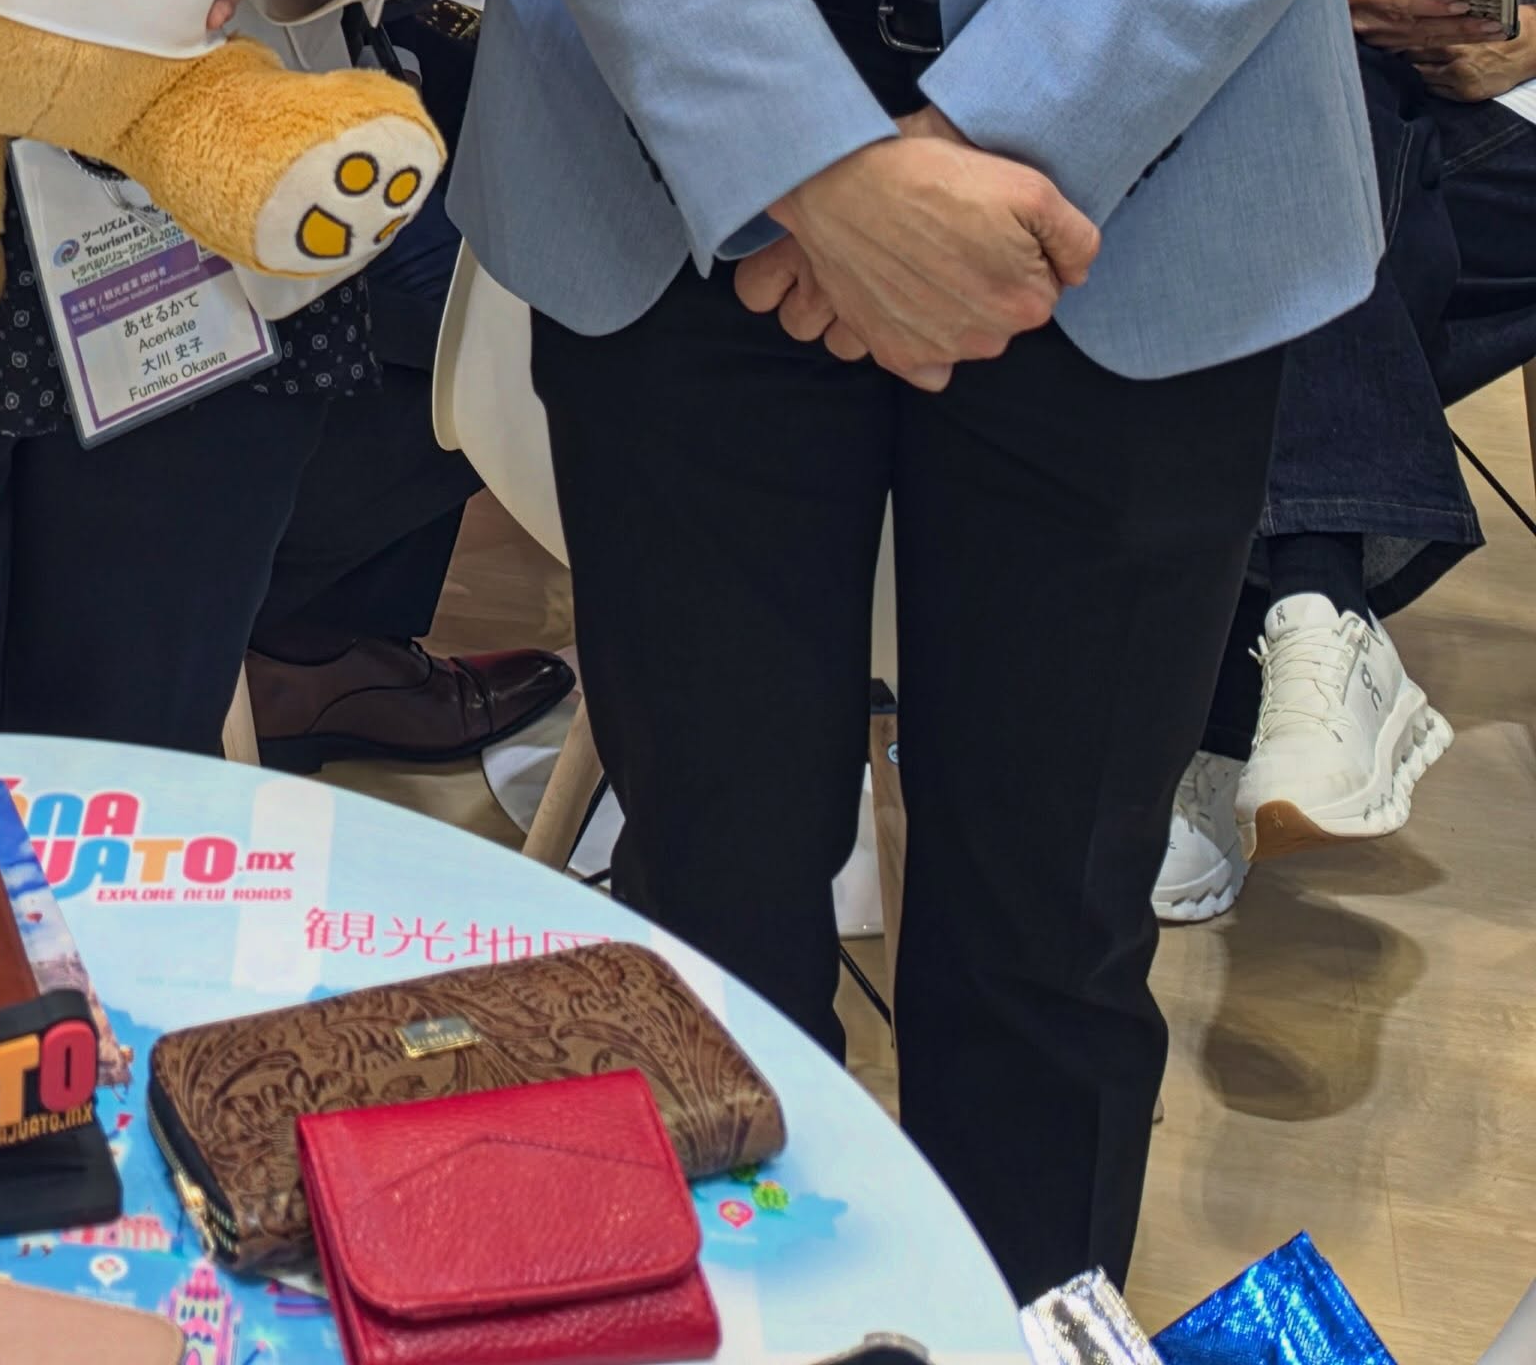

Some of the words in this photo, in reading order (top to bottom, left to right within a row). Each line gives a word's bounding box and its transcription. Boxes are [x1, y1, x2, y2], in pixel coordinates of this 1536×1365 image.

[84, 231, 133, 258] Tourism
[124, 291, 199, 338] あせるかて
[139, 319, 197, 354] Acerkate
[141, 350, 172, 376] 大川
[175, 336, 204, 362] 史子
[128, 373, 179, 402] Fumiko
[181, 351, 228, 378] Okawa
[96, 887, 175, 902] EXPLORE
[233, 887, 294, 902] ROADS
